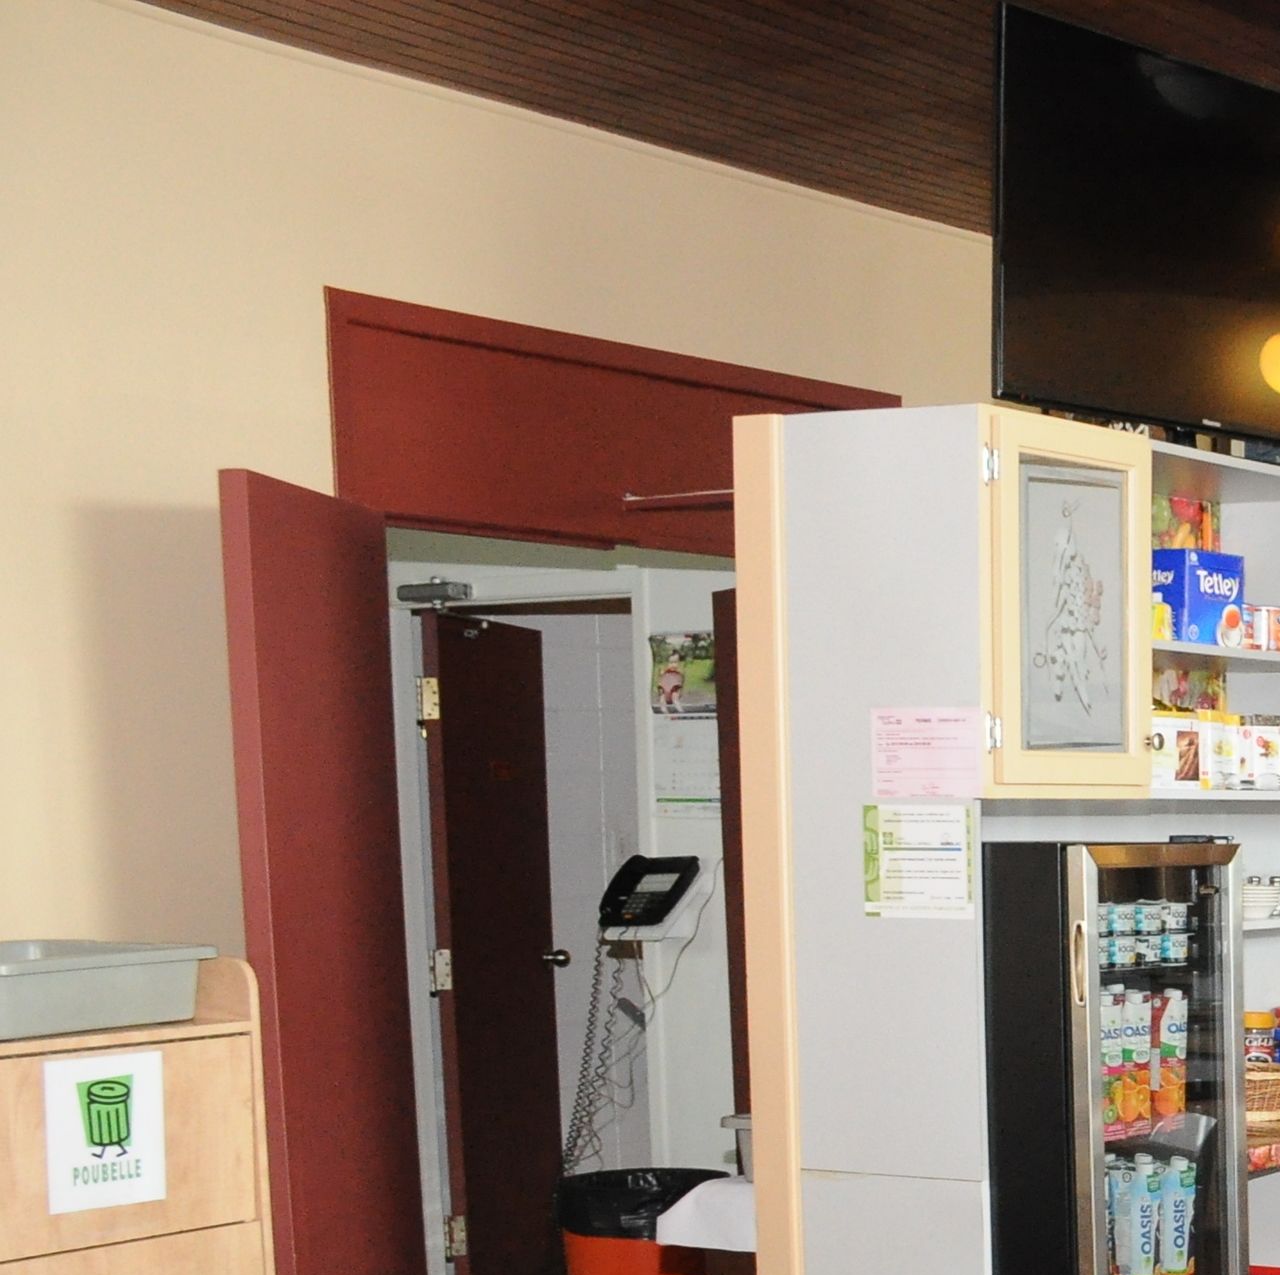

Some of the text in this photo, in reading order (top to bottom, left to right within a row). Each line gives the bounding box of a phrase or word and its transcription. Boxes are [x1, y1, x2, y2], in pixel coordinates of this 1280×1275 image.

[1152, 570, 1174, 585] tley
[1196, 569, 1240, 602] Tetley
[72, 1158, 142, 1187] POUBELLE
[1140, 1204, 1153, 1255] OASIS
[1174, 1199, 1186, 1249] OASIS
